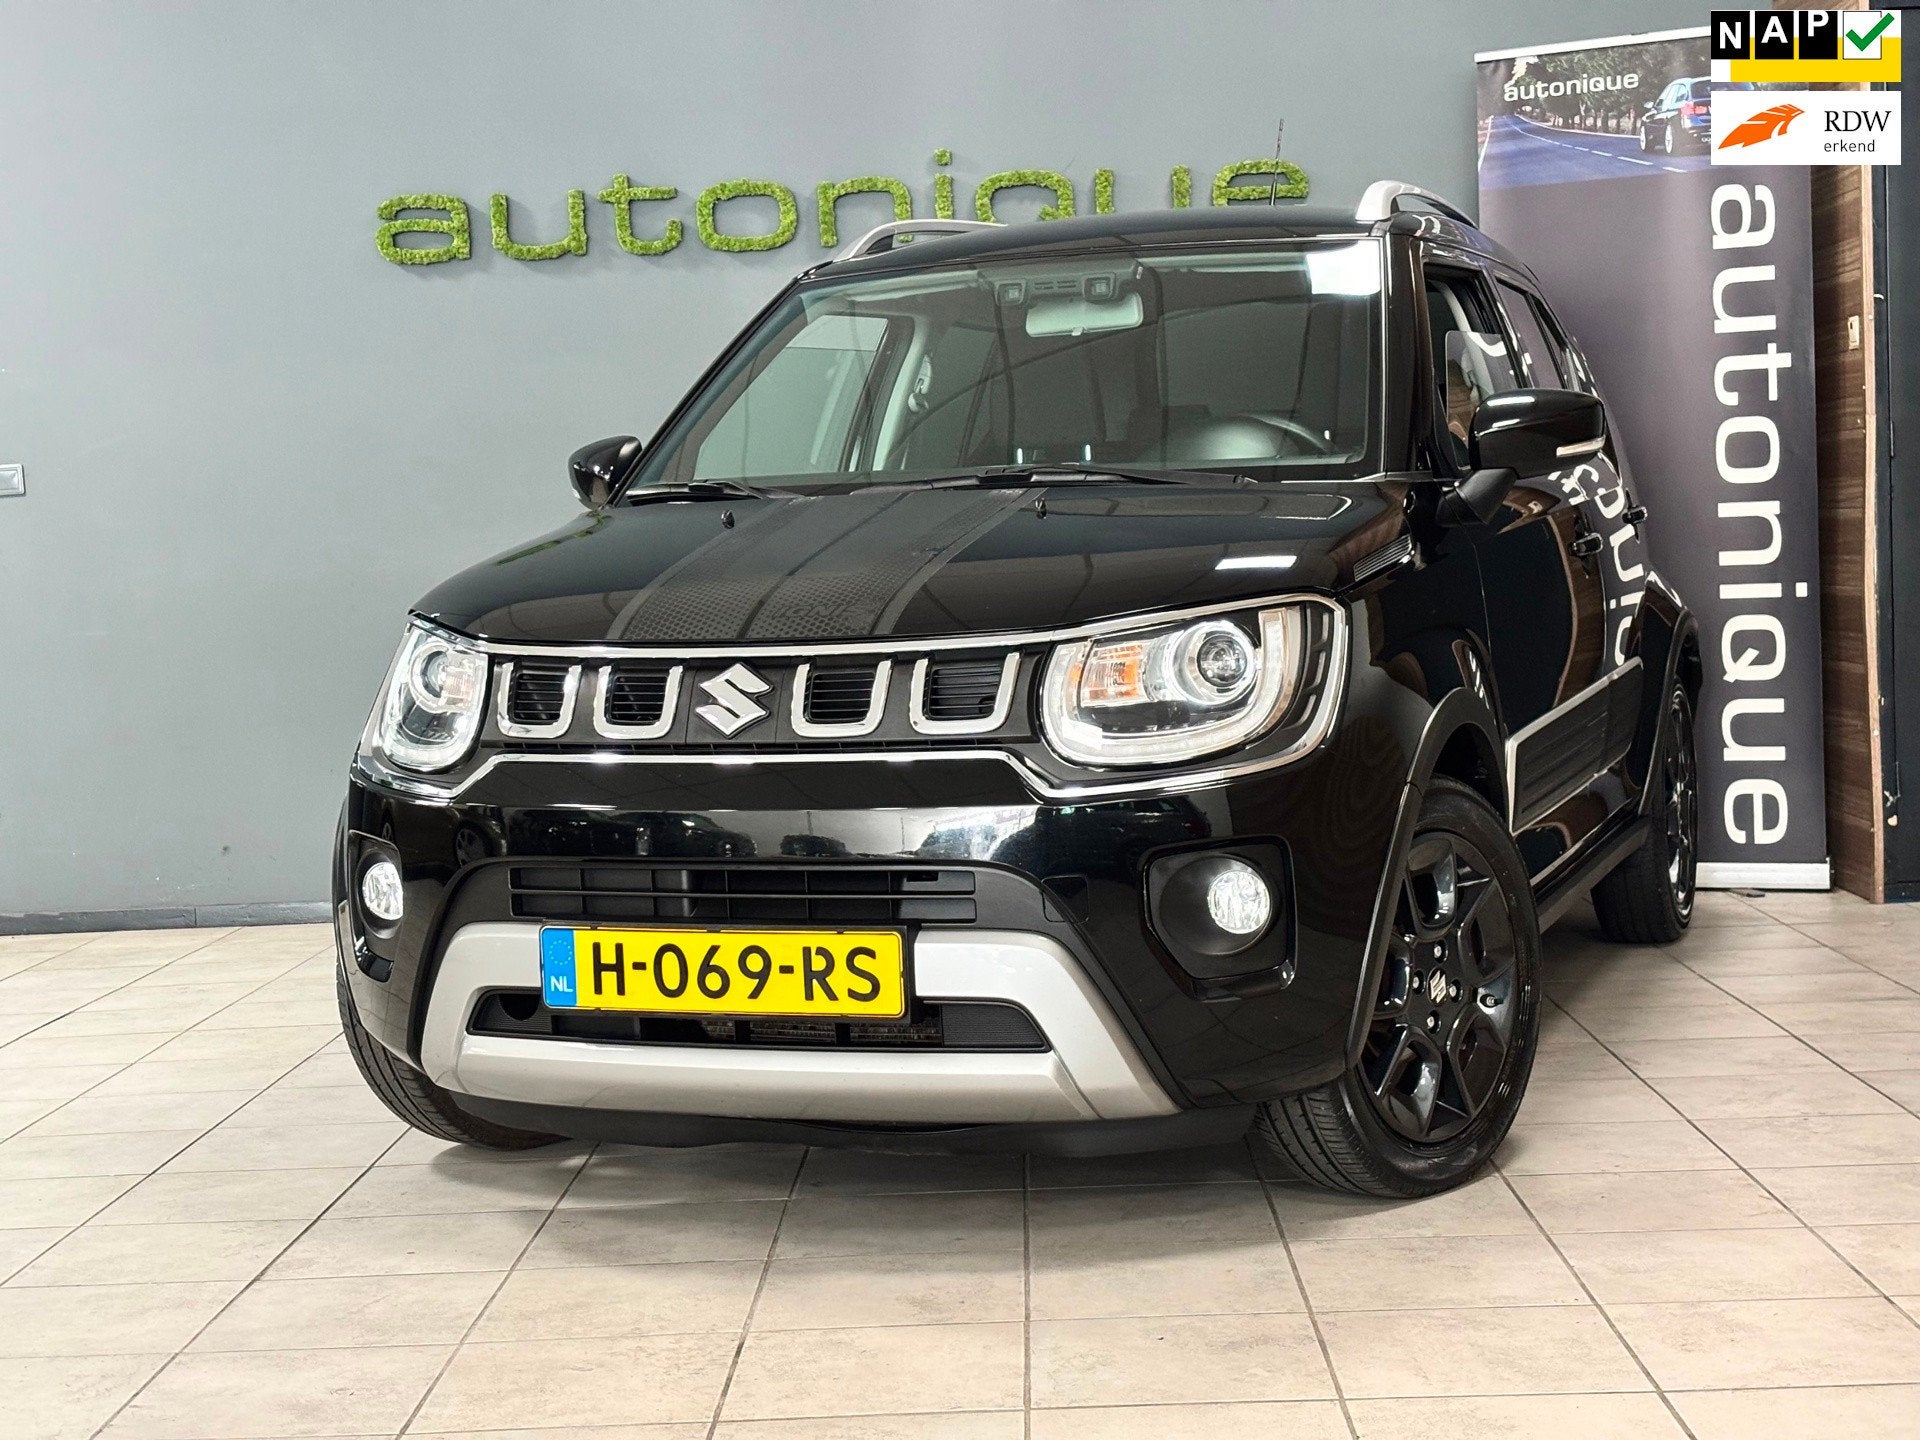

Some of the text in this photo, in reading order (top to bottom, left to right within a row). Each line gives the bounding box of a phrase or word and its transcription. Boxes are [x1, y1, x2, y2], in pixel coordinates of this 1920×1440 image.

[1503, 73, 1639, 102] autonique
[1710, 183, 1808, 845] autonique
[550, 975, 573, 993] NL
[592, 941, 881, 1003] H-069-RS
